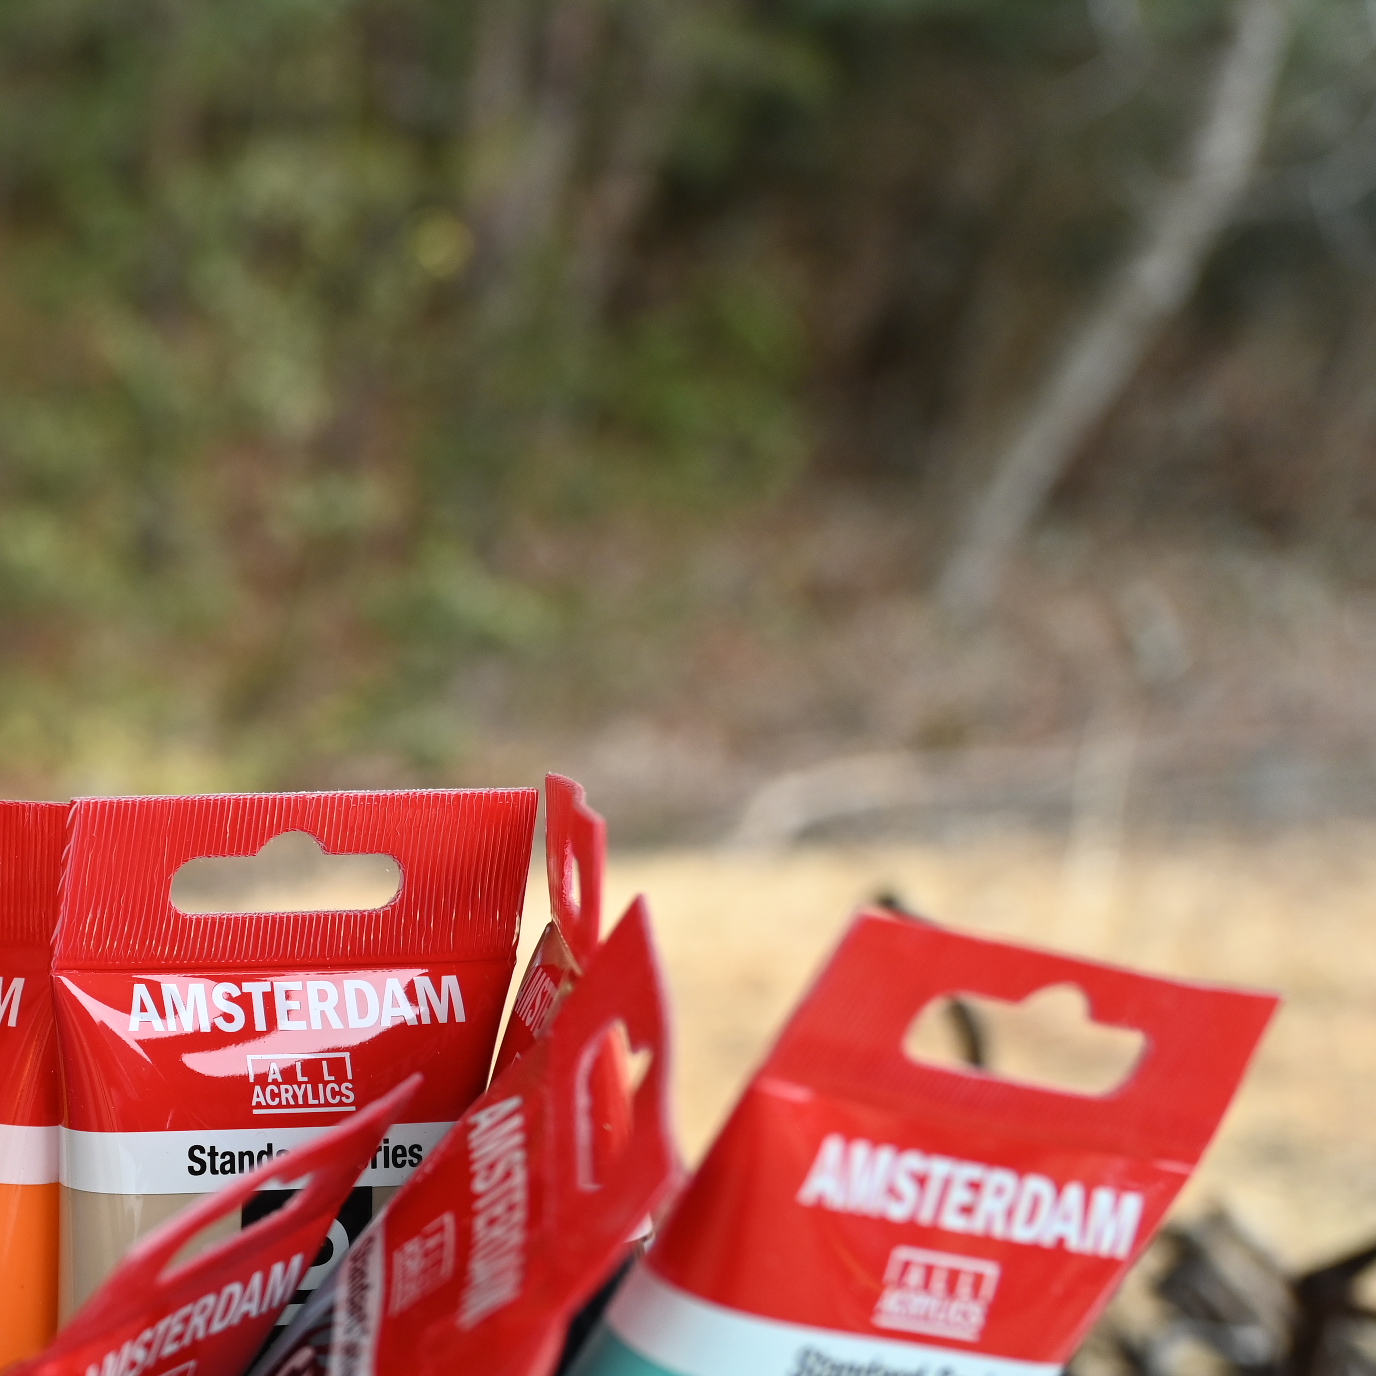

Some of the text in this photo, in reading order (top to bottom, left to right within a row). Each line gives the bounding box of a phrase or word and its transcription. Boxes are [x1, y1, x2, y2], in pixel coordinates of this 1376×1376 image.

[128, 974, 466, 1033] AMSTERDAM
[268, 1061, 336, 1083] ALL
[251, 1082, 355, 1106] ACRYLICS
[187, 1138, 423, 1177] Stand ries
[797, 1132, 1144, 1260] AMSTERDAM
